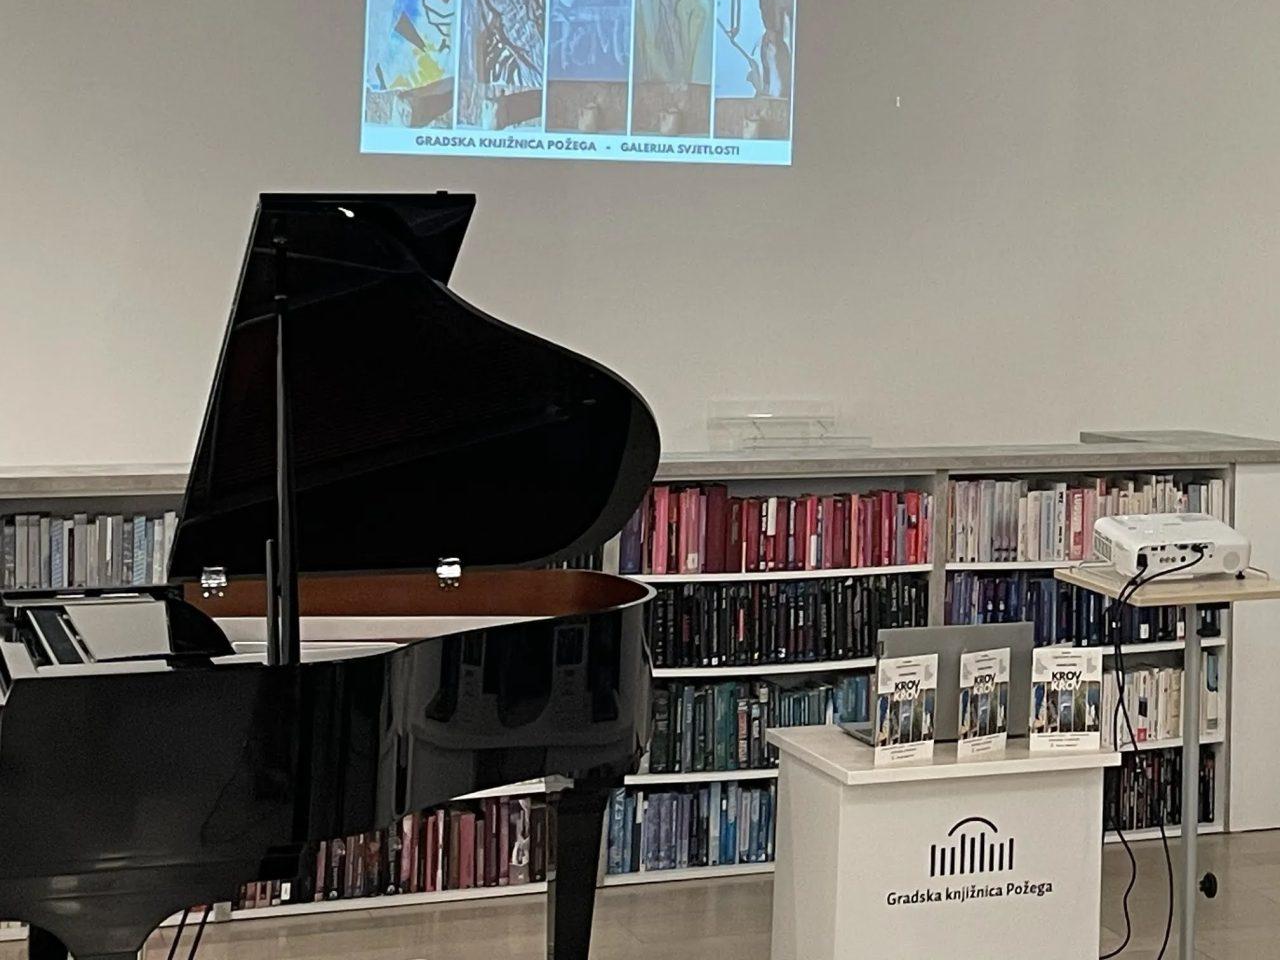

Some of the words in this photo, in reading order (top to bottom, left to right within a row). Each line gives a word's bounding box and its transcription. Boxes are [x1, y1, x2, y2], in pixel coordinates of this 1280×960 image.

[415, 135, 476, 147] GRADSKA
[478, 135, 545, 150] KNJIŽNICA
[546, 138, 597, 151] POŽEGA
[620, 142, 675, 154] GALERIJA
[676, 144, 741, 156] SVJETLOSTI
[1051, 670, 1083, 683] KROV
[894, 679, 921, 694] KROV
[886, 891, 943, 906] Gradska
[945, 884, 1003, 903] knjižnica
[1006, 880, 1054, 898] Požega
